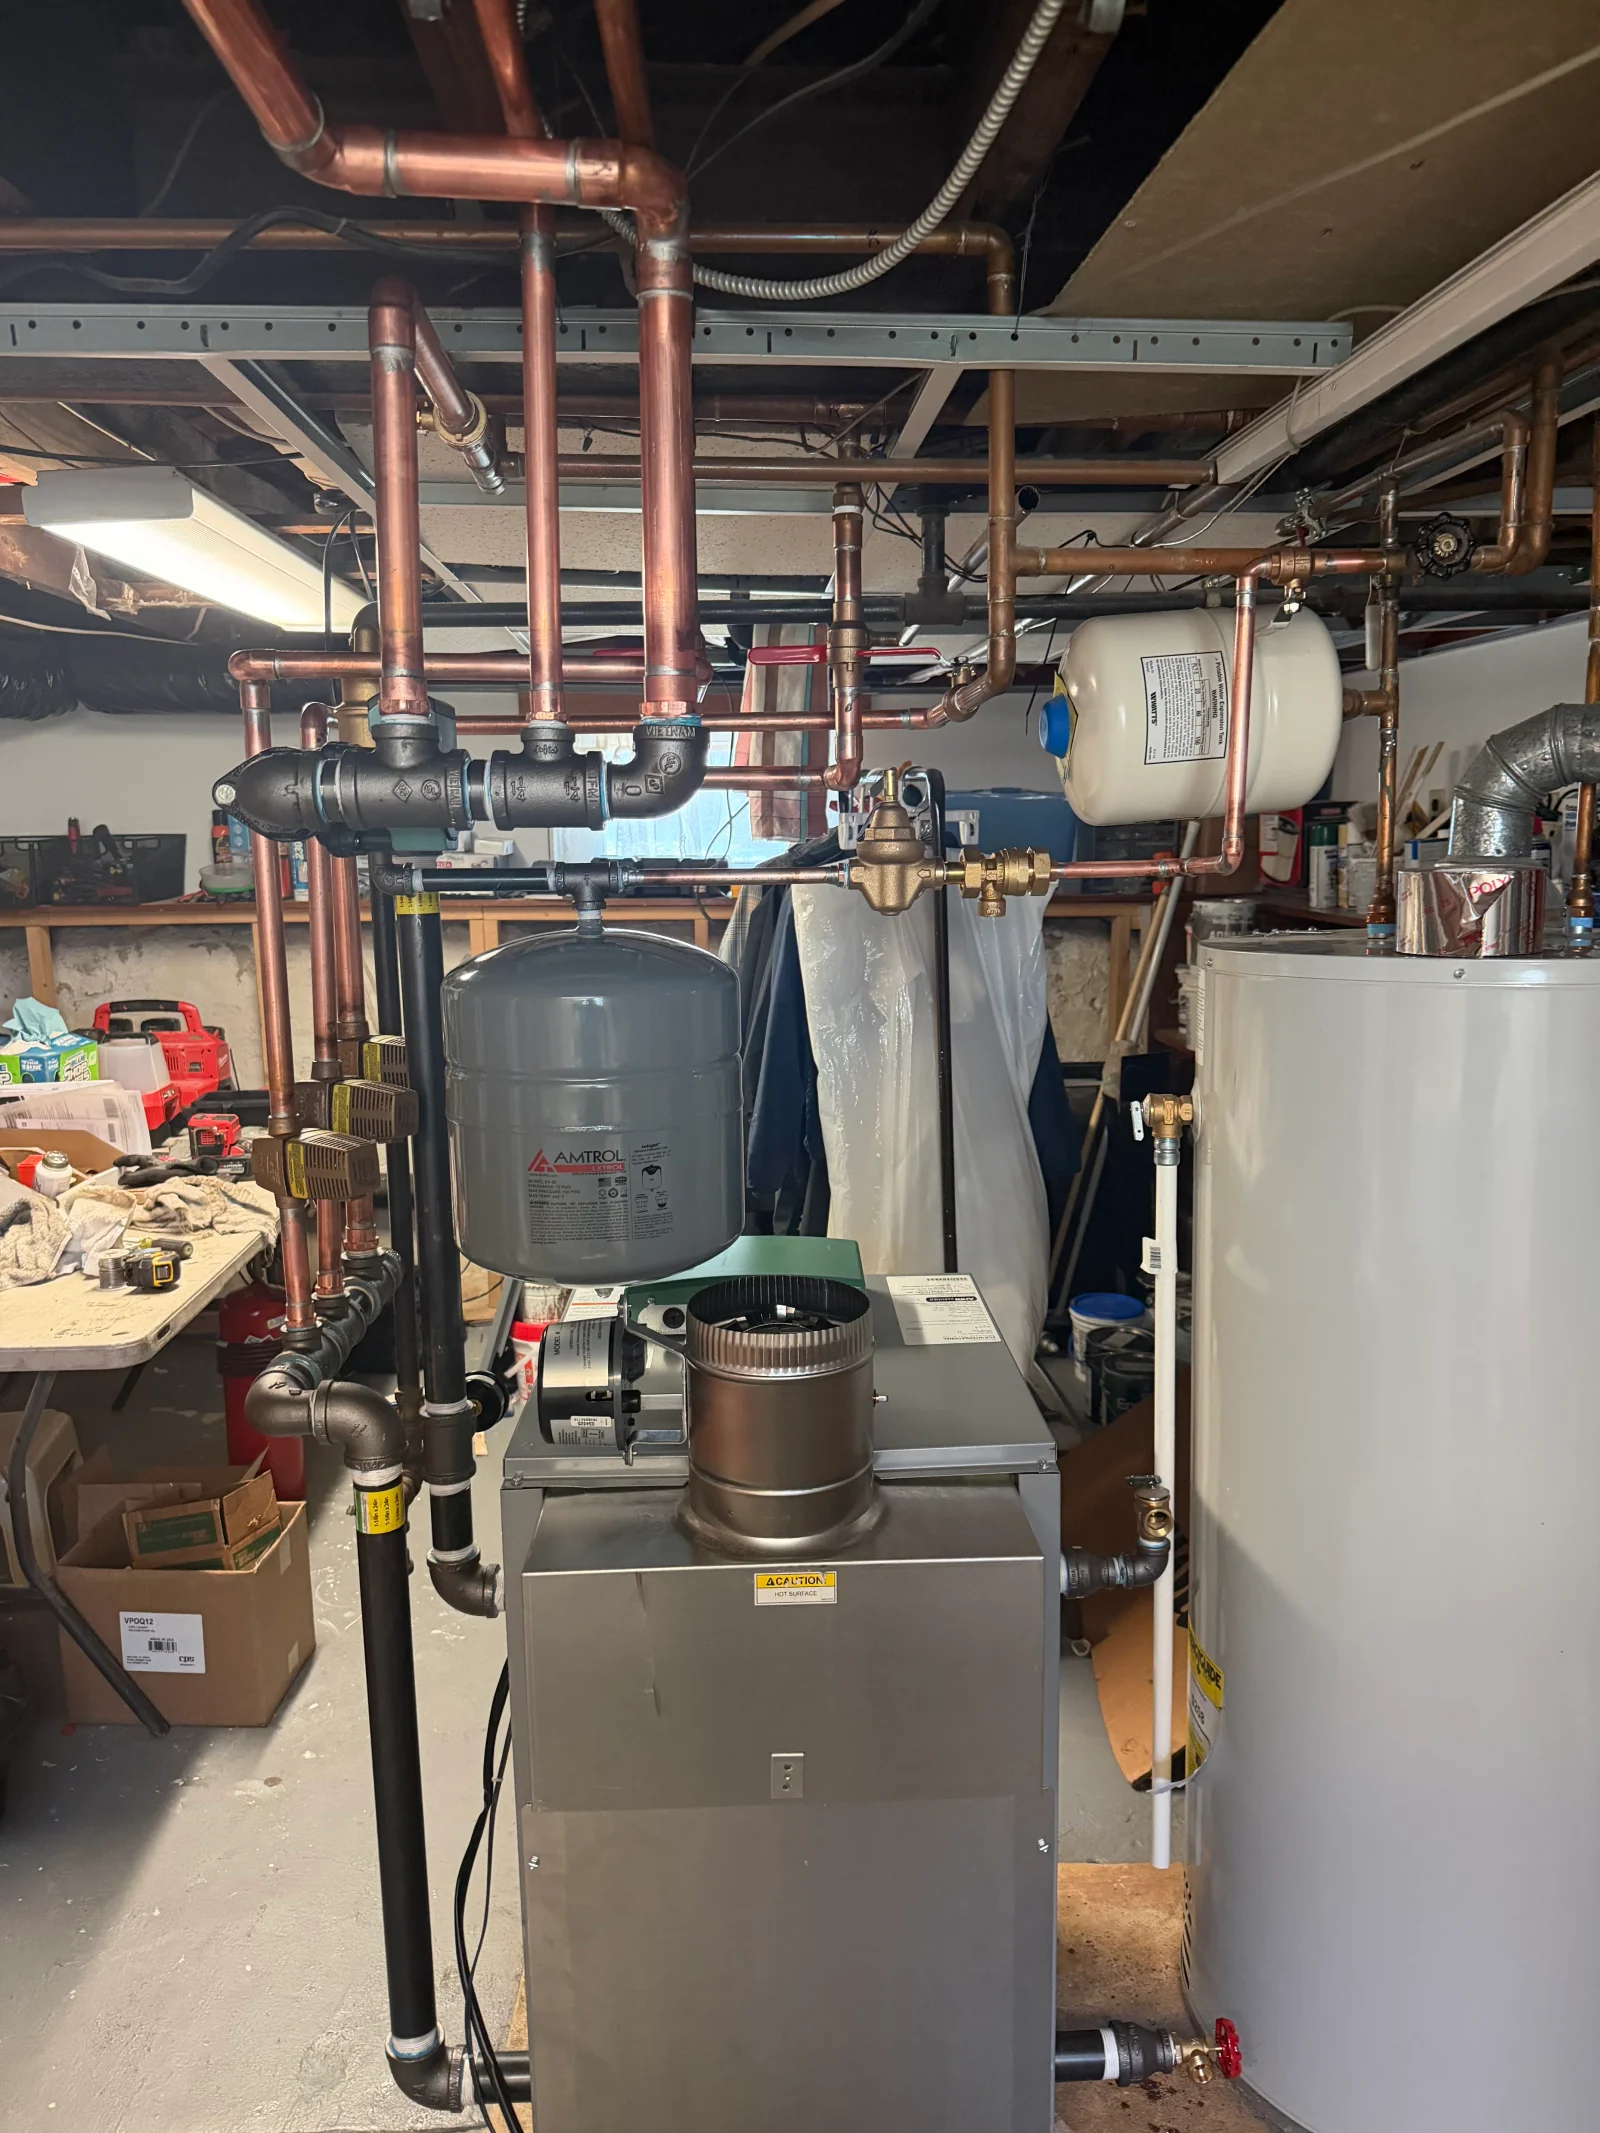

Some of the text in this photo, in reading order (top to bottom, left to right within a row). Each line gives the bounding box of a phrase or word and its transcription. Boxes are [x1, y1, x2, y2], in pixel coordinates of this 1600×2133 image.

[646, 726, 696, 738] VIETNAM
[554, 1150, 624, 1164] AMTROL
[124, 1617, 154, 1625] VPOQ12
